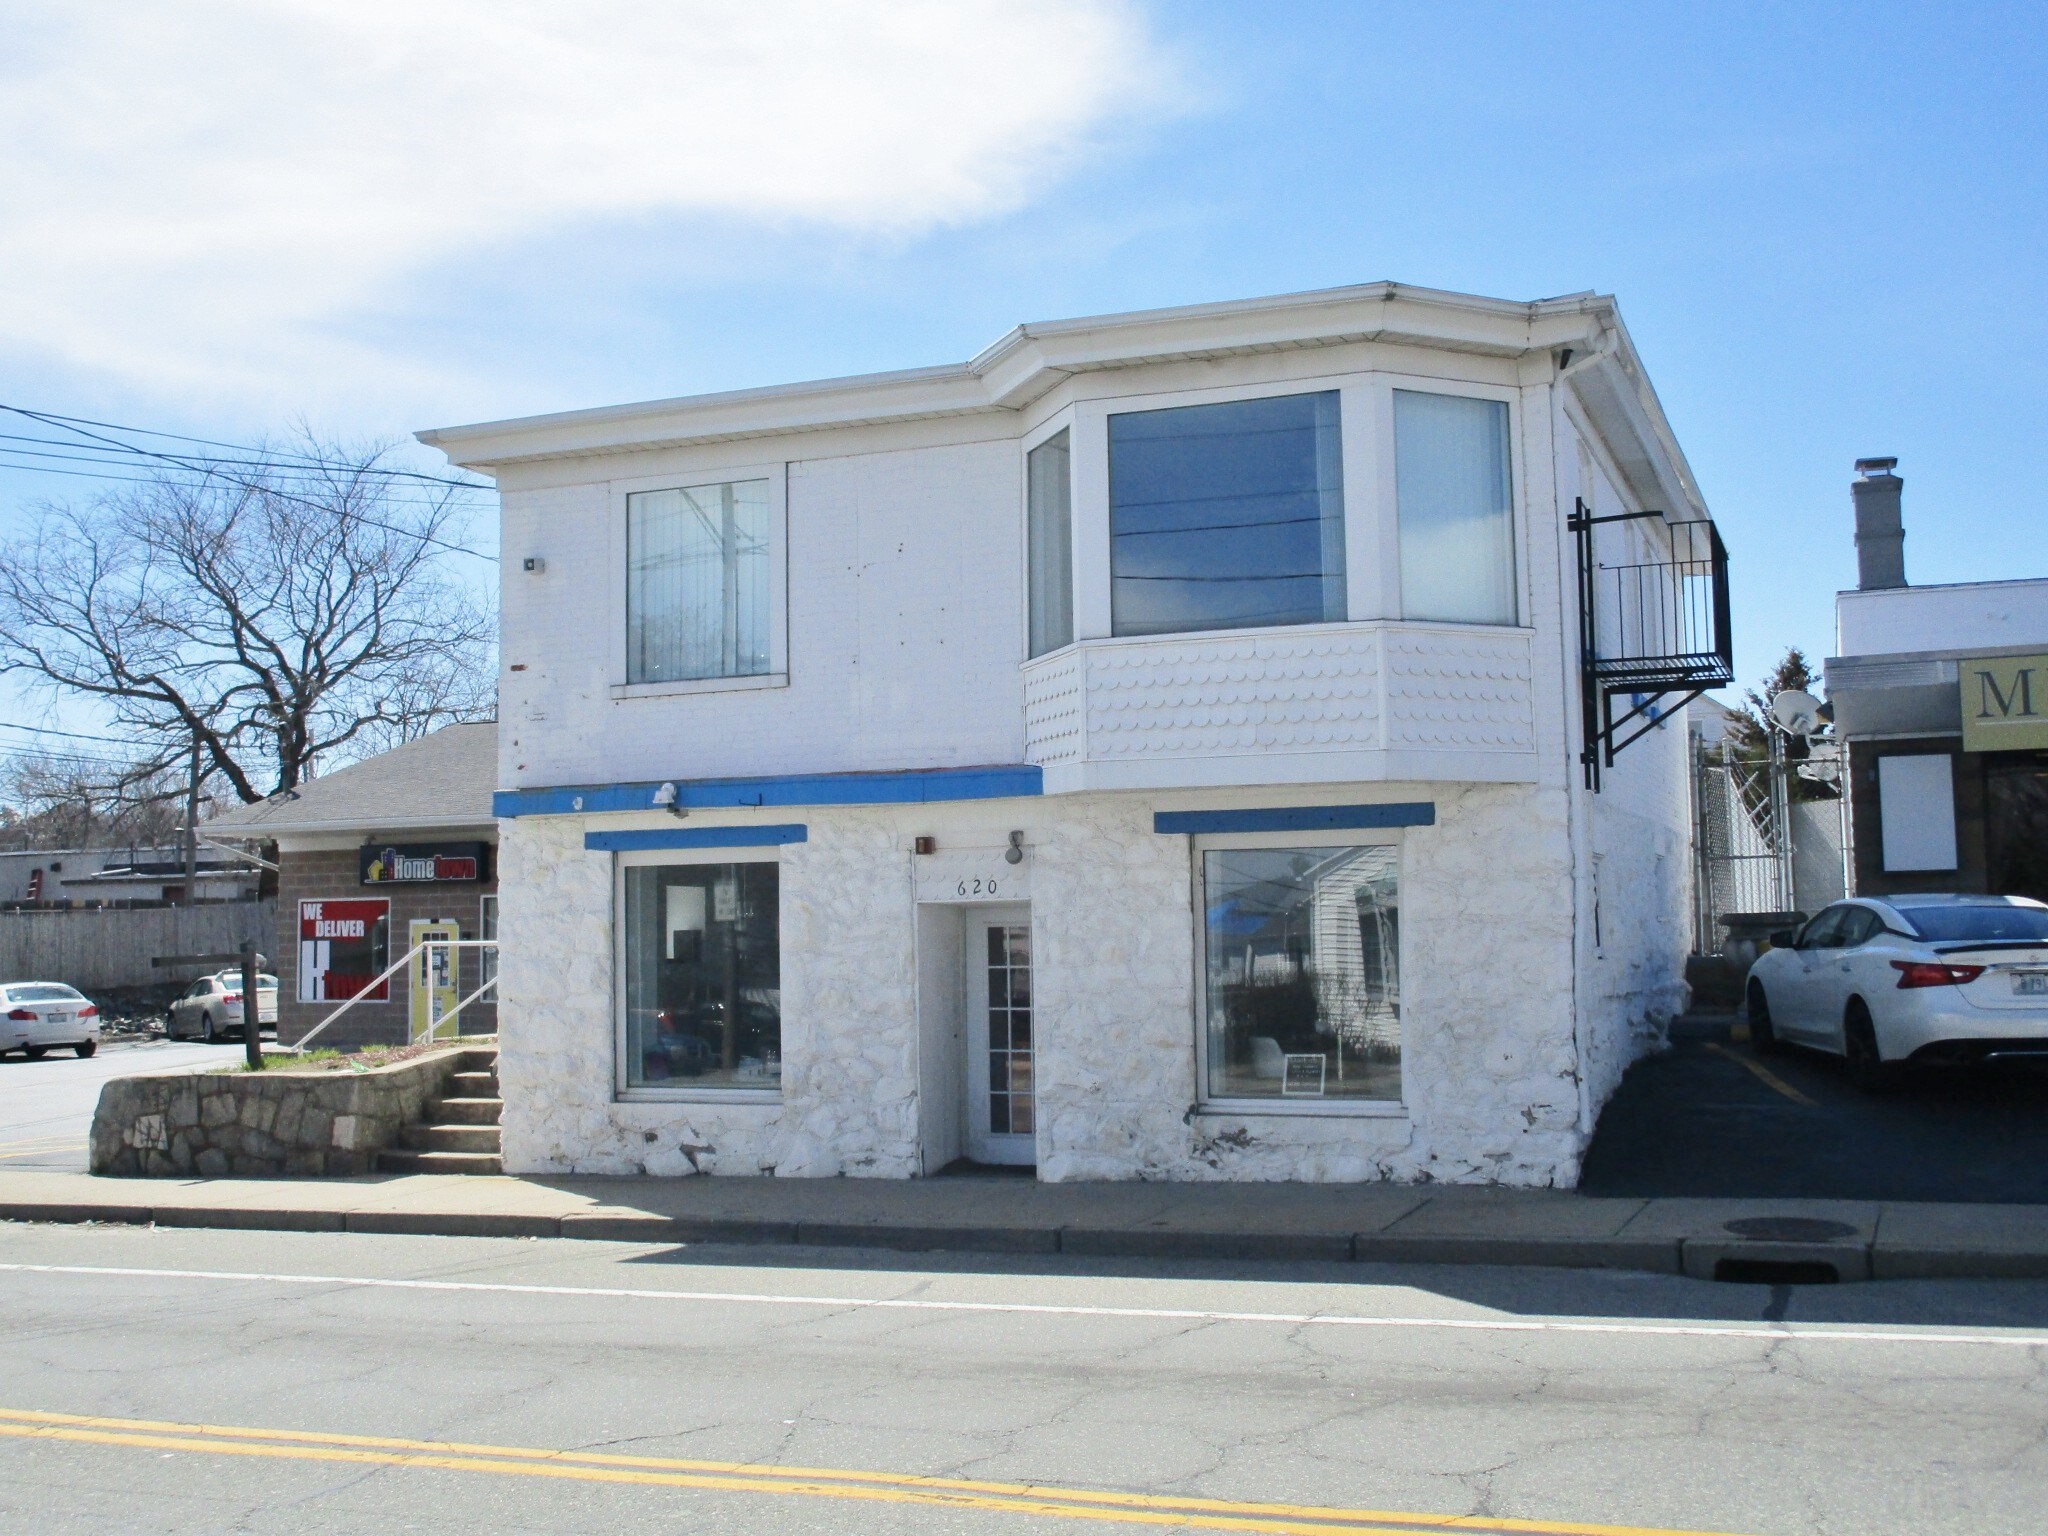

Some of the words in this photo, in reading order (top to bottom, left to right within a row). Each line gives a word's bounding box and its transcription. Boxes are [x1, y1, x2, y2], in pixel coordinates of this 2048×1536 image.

[1973, 668, 2048, 718] M
[393, 855, 475, 880] Hometown
[957, 879, 997, 896] 620
[303, 903, 323, 920] WE
[315, 920, 365, 937] DELIVER
